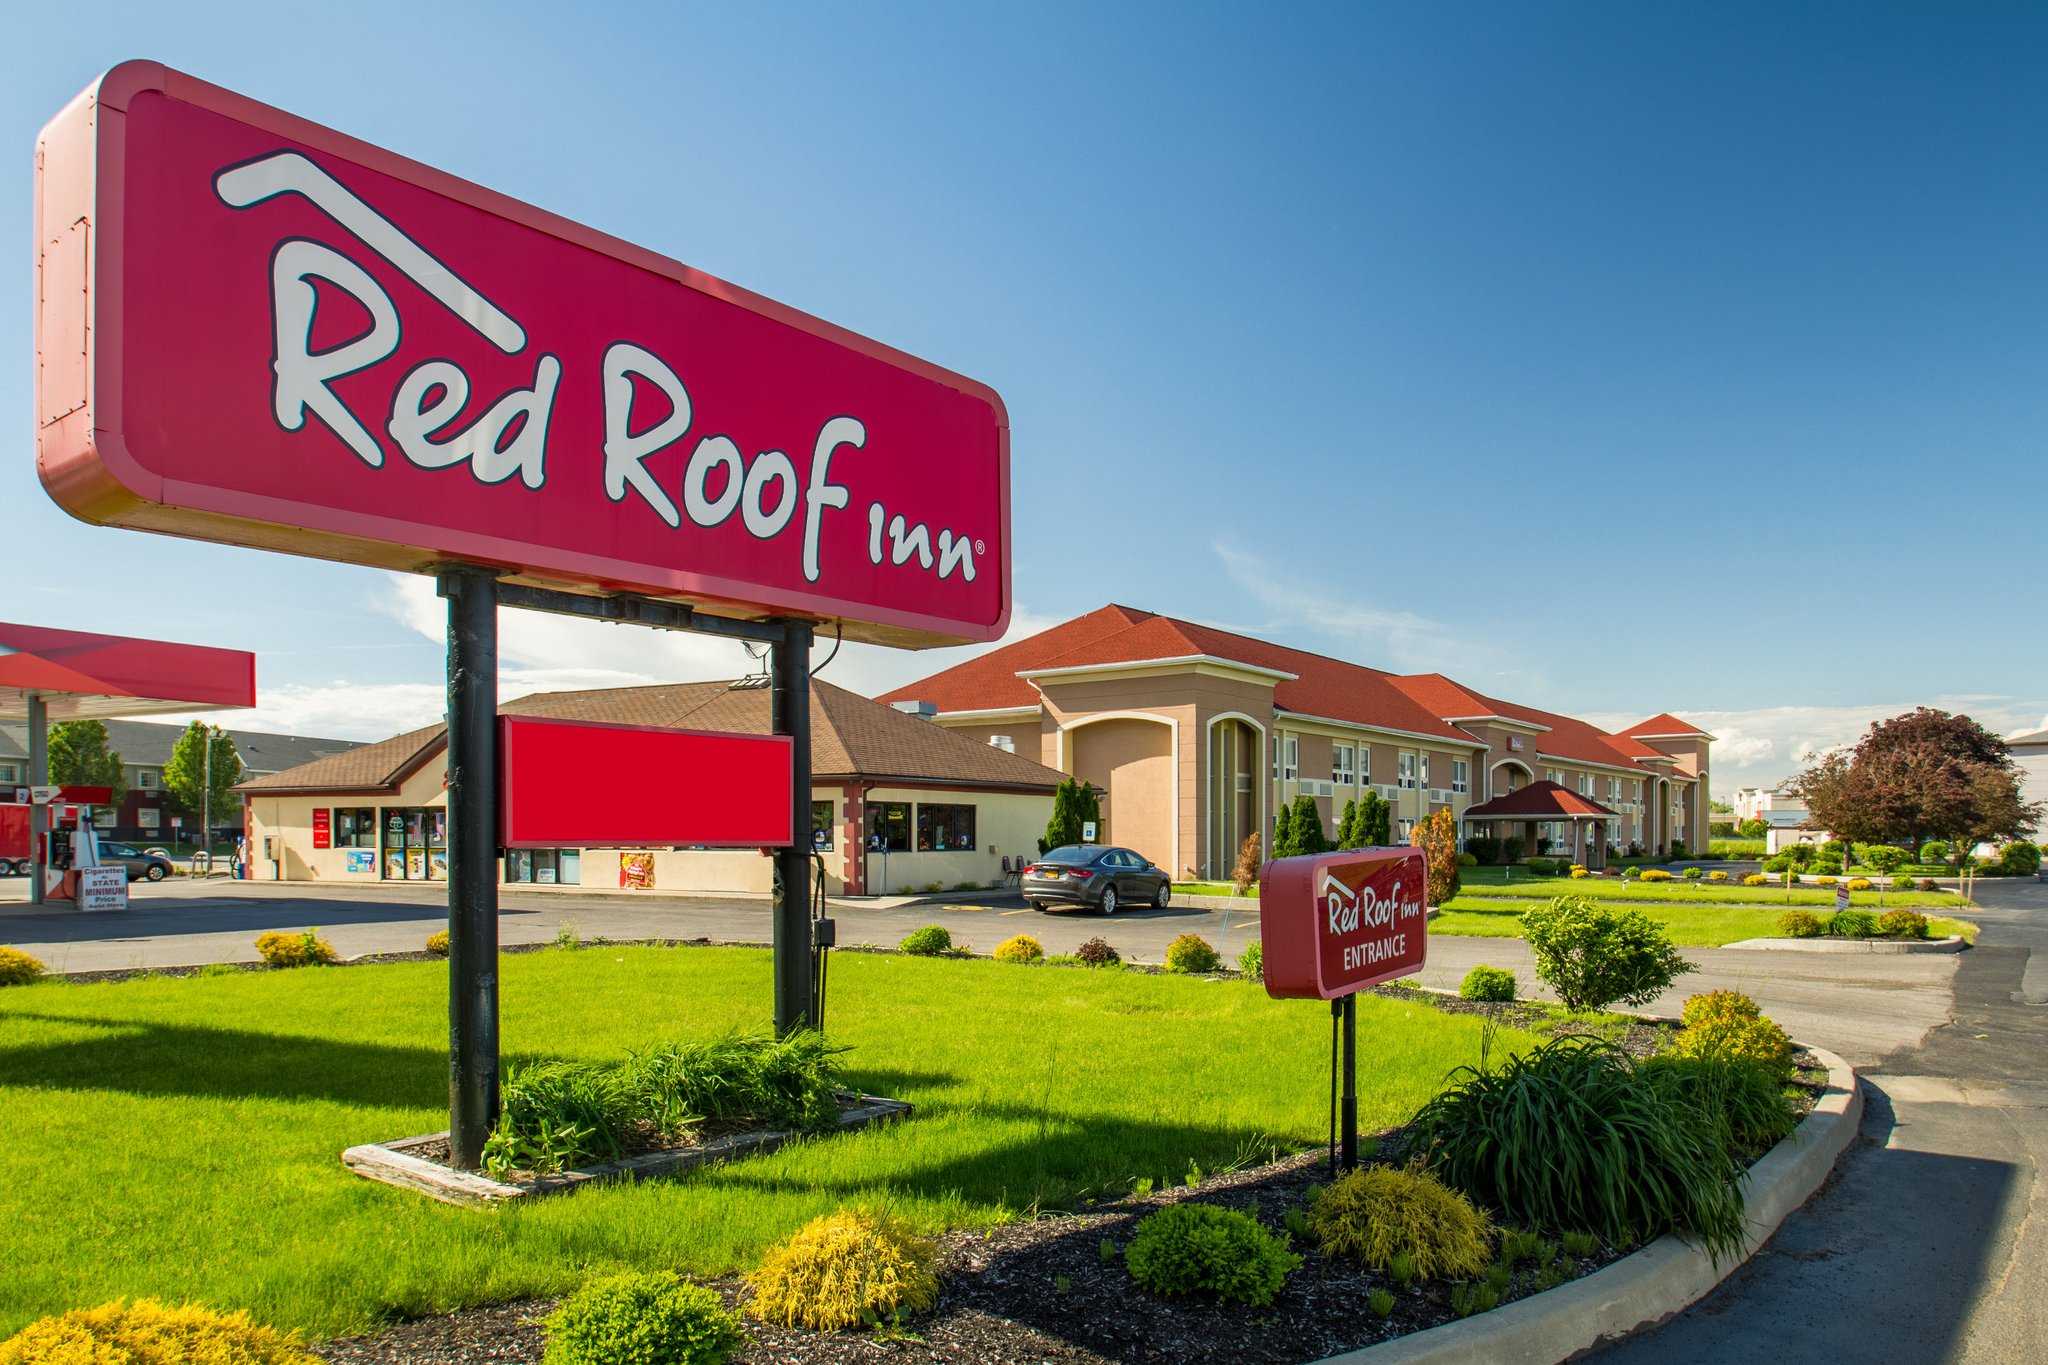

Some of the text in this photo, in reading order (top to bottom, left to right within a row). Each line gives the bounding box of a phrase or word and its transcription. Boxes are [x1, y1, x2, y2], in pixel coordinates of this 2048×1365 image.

[269, 238, 562, 490] Red
[603, 341, 866, 582] Roof
[85, 887, 125, 896] MINIMUM
[92, 879, 120, 887] STATE
[1328, 891, 1360, 936] Red
[1363, 881, 1401, 931] Roof
[1343, 933, 1407, 971] ENTRANCE
